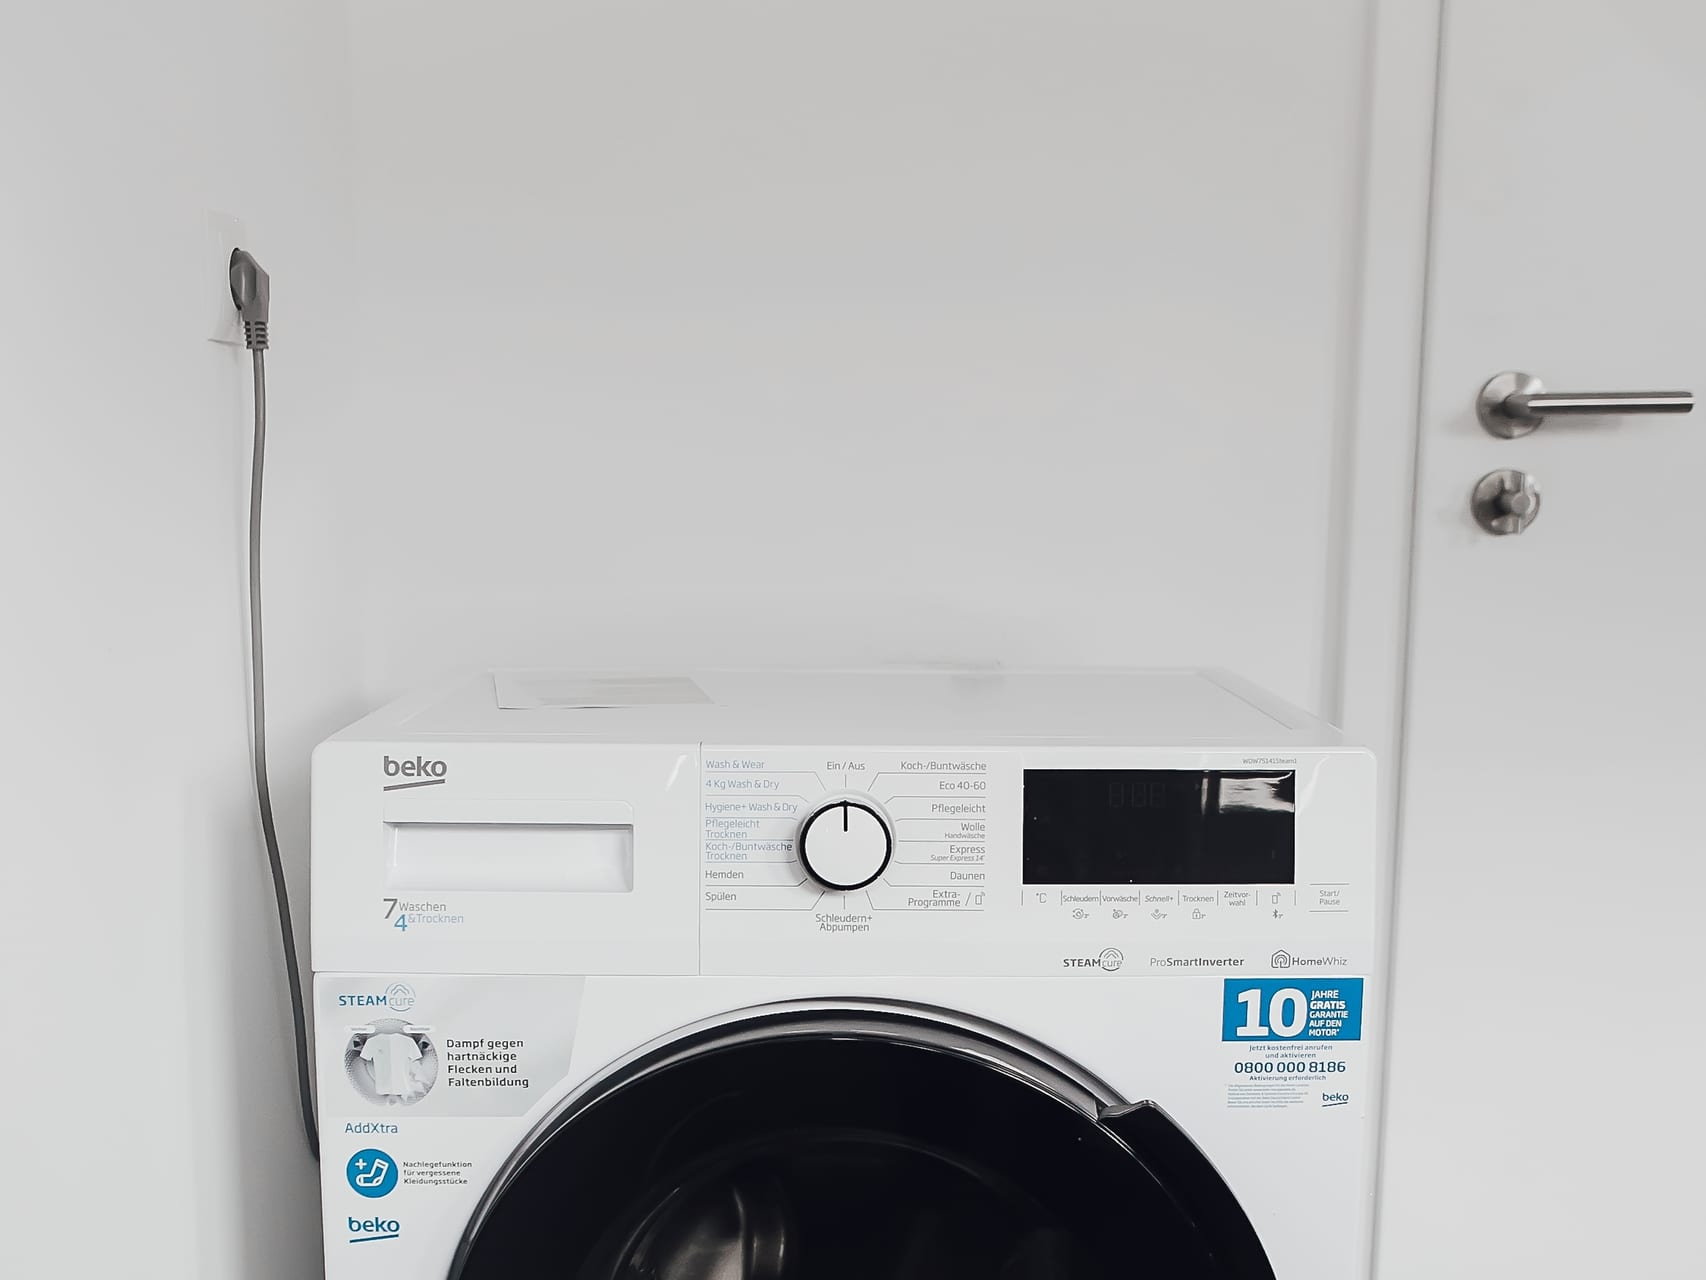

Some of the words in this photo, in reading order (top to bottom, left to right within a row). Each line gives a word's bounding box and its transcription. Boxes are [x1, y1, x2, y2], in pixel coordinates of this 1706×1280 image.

[383, 756, 447, 777] beko
[705, 760, 730, 769] Wash
[732, 760, 741, 769] &
[742, 760, 765, 769] Wear
[827, 762, 840, 770] Ein
[849, 762, 865, 770] Aus
[901, 762, 987, 771] Koch-/Buntwäsche
[706, 780, 712, 788] 4
[713, 780, 727, 790] Kg
[728, 780, 752, 788] Wash
[754, 780, 762, 788] &
[763, 780, 780, 790] Dry
[939, 781, 955, 790] Eco
[957, 781, 986, 790] 40-60
[705, 803, 746, 813] Hygiene+
[749, 803, 773, 812] Wash
[774, 803, 780, 812] &
[782, 803, 798, 813] Dry
[931, 804, 986, 814] Pflegeleicht
[705, 819, 760, 830] Pflegeleicht
[961, 823, 986, 831] Wolle
[705, 830, 748, 839] Trocknen
[705, 842, 793, 851] Koch-/Buntwäsche
[950, 845, 986, 855] Express
[705, 852, 748, 861] Trocknen
[705, 870, 744, 879] Hemden
[950, 872, 985, 880] Daunen
[705, 892, 737, 902] Spülen
[932, 890, 960, 898] Extra-
[1036, 893, 1047, 903] °C
[908, 898, 960, 907] Programme
[1319, 898, 1340, 906] Pause
[383, 899, 398, 919] 7
[399, 902, 447, 912] Waschen
[394, 914, 408, 931] 4
[815, 914, 873, 923] Schleudern+
[819, 923, 869, 932] Abpumpen
[1150, 958, 1244, 967] ProSmartInverter
[1292, 957, 1347, 966] HomeWhiz
[1311, 990, 1339, 1000] JAHRE
[1310, 1001, 1346, 1010] GRATIS
[1236, 988, 1308, 1037] 10
[446, 1039, 484, 1048] Dampf
[487, 1040, 524, 1049] gegen
[447, 1052, 517, 1062] hartnäckige
[448, 1065, 492, 1074] Flecken
[495, 1065, 517, 1074] und
[1234, 1062, 1273, 1073] 0800
[1276, 1062, 1306, 1073] 000
[1308, 1061, 1346, 1073] 8186
[448, 1077, 529, 1088] Faltenbildung
[1322, 1092, 1349, 1101] beko
[345, 1123, 398, 1133] AddXtra
[348, 1216, 400, 1232] beko
